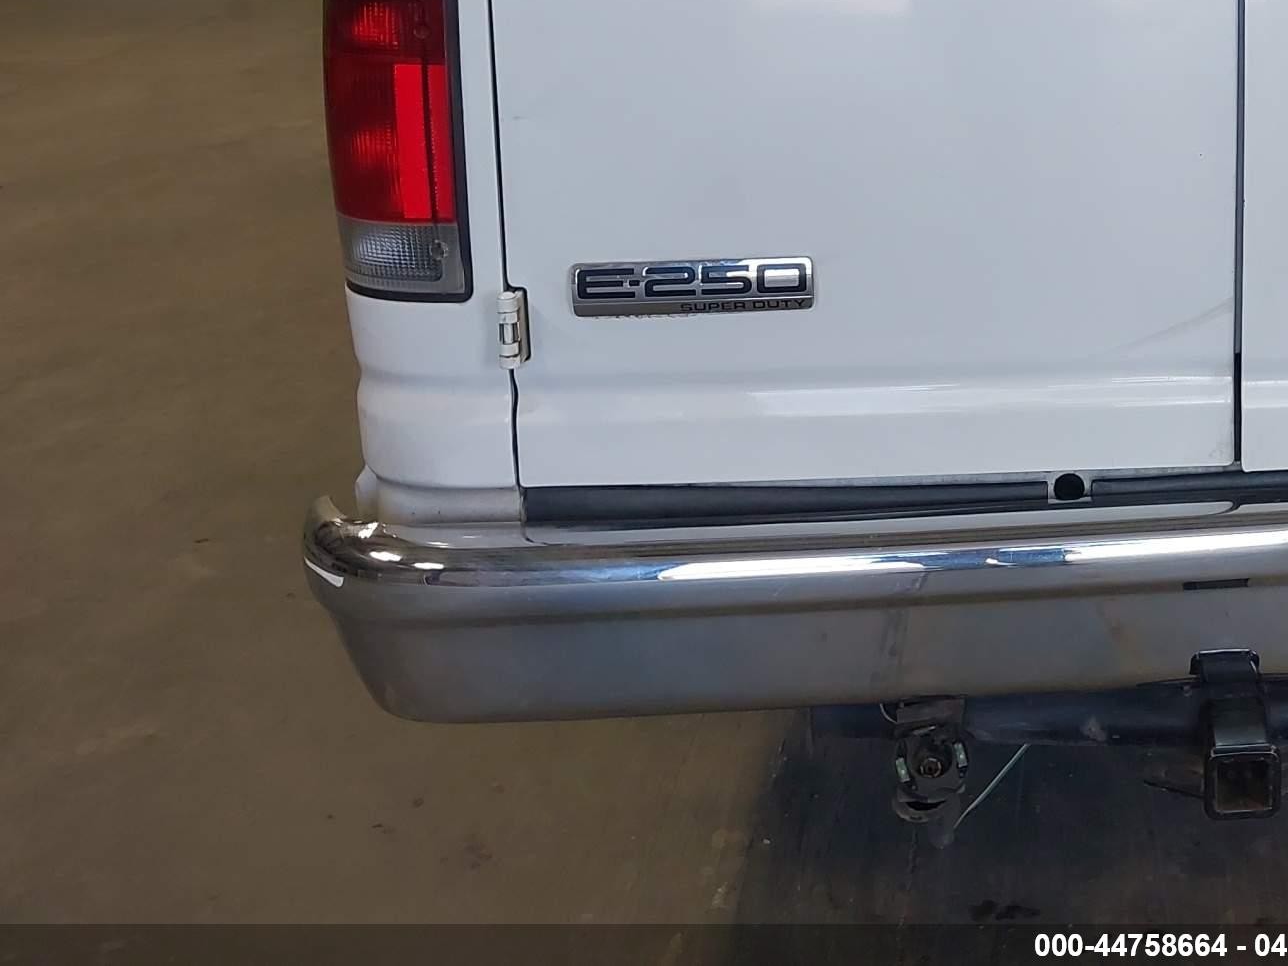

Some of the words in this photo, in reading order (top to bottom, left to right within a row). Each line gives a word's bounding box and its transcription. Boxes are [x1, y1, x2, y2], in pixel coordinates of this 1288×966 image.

[577, 263, 808, 299] E-250
[680, 301, 746, 312] SUPER
[752, 299, 806, 309] DUTY
